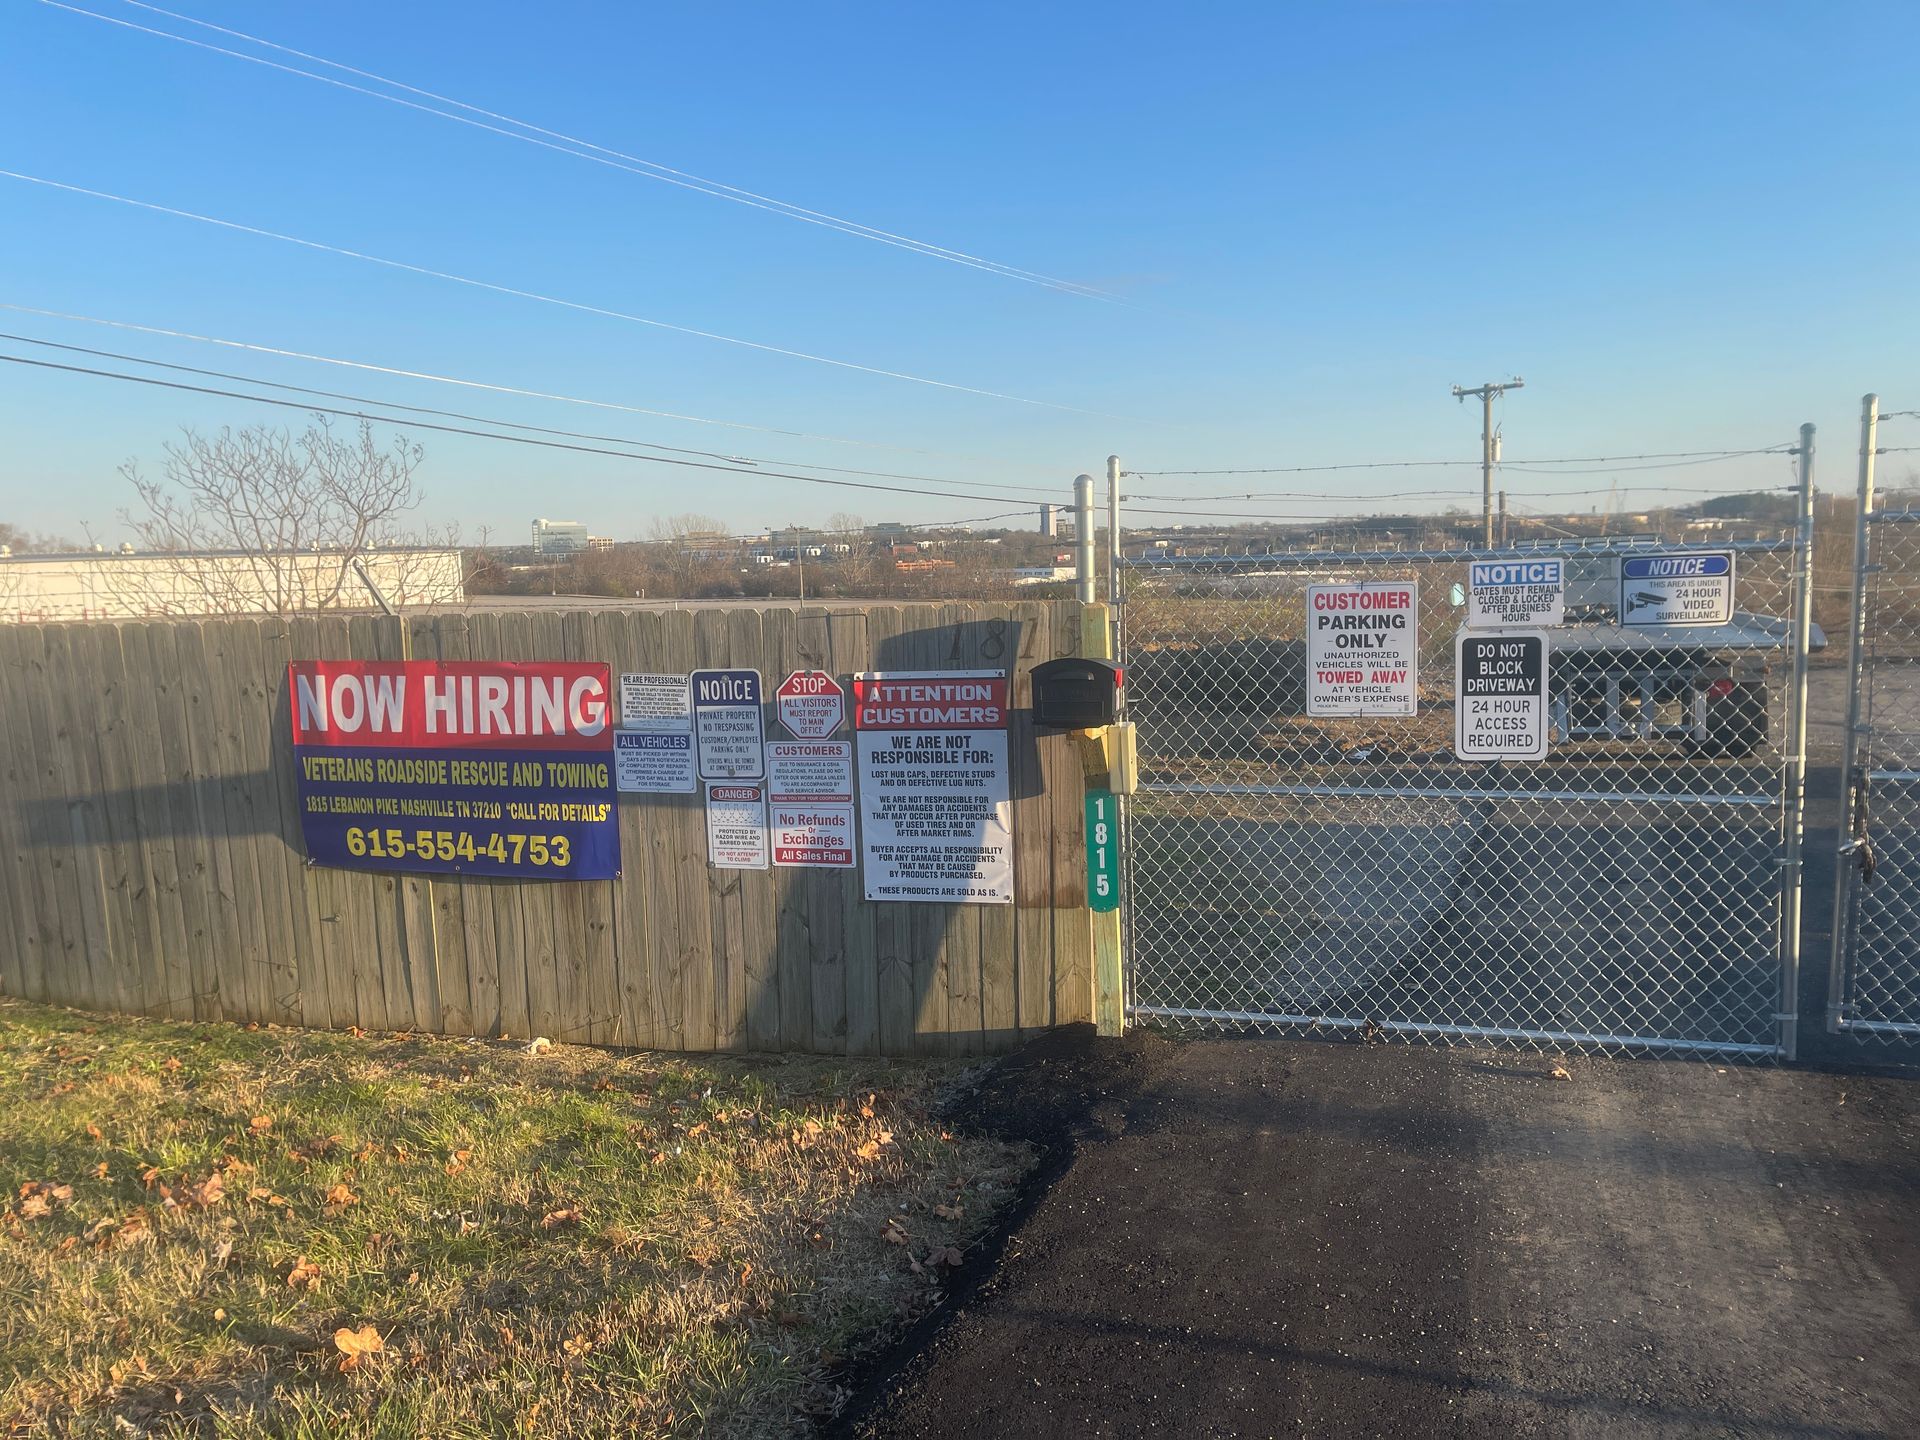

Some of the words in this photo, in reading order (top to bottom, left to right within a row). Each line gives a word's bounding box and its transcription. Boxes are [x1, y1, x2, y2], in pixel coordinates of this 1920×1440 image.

[1648, 559, 1706, 576] NOTICE
[1474, 566, 1558, 585] NOTICE
[1696, 579, 1722, 587] UNDER
[1473, 587, 1500, 596] GATES
[1502, 586, 1526, 595] MUST
[1527, 584, 1560, 595] REMAIN
[1676, 589, 1689, 598] 24
[1693, 588, 1721, 598] HOUR
[1314, 591, 1410, 610] CUSTOMER
[1478, 594, 1510, 604] CLOSED
[1512, 594, 1518, 604] &
[1521, 594, 1555, 603] LOCKED
[1683, 600, 1715, 609] VIDEO
[1481, 604, 1508, 614] AFTER
[1509, 603, 1551, 613] BUSINESS
[1501, 613, 1531, 622] HOURS
[1655, 611, 1721, 620] SURVEILLANCE
[1318, 614, 1406, 630] PARKING
[1335, 634, 1387, 648] ONLY
[1324, 651, 1399, 659] UNAUTHORIZED
[1477, 644, 1494, 658] DO
[1500, 643, 1526, 658] NOT
[1479, 661, 1523, 675] BLOCK
[632, 676, 642, 684] ARE
[643, 676, 688, 685] PROFESSIONALS
[1317, 671, 1363, 684] TOWED
[1370, 671, 1406, 683] AWAY
[699, 680, 753, 701] NOTICE
[792, 677, 827, 693] STOP
[1467, 678, 1535, 692] DRIVEWAY
[868, 683, 992, 703] ATTENTION
[297, 674, 409, 733] NOW
[424, 675, 606, 736] HIRING
[784, 699, 799, 707] ALL
[801, 698, 837, 707] VISITORS
[1471, 701, 1488, 714] 24
[1494, 700, 1530, 713] HOUR
[699, 711, 724, 720] PRIVATE
[726, 711, 756, 720] PROPERTY
[808, 709, 832, 717] REPORT
[863, 706, 1000, 724] CUSTOMERS
[703, 723, 712, 732] NO
[714, 722, 755, 732] TRESPASSING
[799, 718, 807, 726] TO
[808, 718, 824, 726] MAIN
[1475, 717, 1527, 730] ACCESS
[620, 736, 638, 748] ALL
[639, 736, 687, 748] VEHICLES
[700, 735, 759, 746] CUSTOMER/EMPLOYEE
[891, 736, 912, 748] WE
[915, 736, 941, 748] ARE
[947, 735, 971, 748] NOT
[1468, 734, 1533, 747] REQUIRED
[775, 746, 843, 756] CUSTOMERS
[871, 751, 959, 763] RESPONSIBLE
[964, 751, 994, 763] FOR:
[302, 756, 374, 783] VETERANS
[377, 758, 447, 785] ROADSIDE
[451, 760, 508, 786] RESCUE
[512, 761, 543, 787] AND
[548, 762, 609, 789] TOWING
[896, 779, 907, 787] OR
[909, 779, 947, 787] DEFECTIVE
[949, 779, 963, 787] LUG
[965, 779, 986, 787] NUTS.
[718, 789, 753, 799] DANGER
[306, 796, 328, 813] 1815
[330, 796, 374, 815] LEBANON
[376, 798, 399, 815] PIKE
[401, 798, 454, 817] NASHVILLE
[455, 800, 470, 818] TN
[473, 800, 501, 818] 37210
[505, 801, 537, 820] “CALL
[539, 802, 560, 820] FOR
[562, 802, 611, 822] DETAILS”
[882, 804, 896, 812] ANY
[898, 804, 932, 812] DAMAGES
[779, 813, 794, 825] No
[799, 814, 845, 826] Refunds
[872, 812, 889, 820] THAT
[892, 812, 907, 820] MAY
[960, 813, 999, 821] PURCHASE
[895, 821, 903, 829] OF
[905, 821, 923, 829] USED
[925, 821, 945, 829] TIRES
[947, 821, 962, 829] AND
[965, 821, 976, 829] OR
[782, 833, 844, 848] Exchanges
[346, 827, 571, 867] 615-554-4753
[895, 846, 928, 854] ACCEPTS
[930, 846, 942, 854] ALL
[944, 846, 1003, 854] RESPONSIBILITY
[1095, 797, 1110, 897] 1815
[782, 850, 793, 860] All
[795, 851, 820, 861] Sales
[823, 851, 846, 861] Final
[878, 854, 892, 862] FOR
[894, 854, 907, 862] ANY
[910, 854, 940, 862] DAMAGE
[948, 863, 976, 871] CAUSED
[901, 871, 940, 879] PRODUCTS
[940, 871, 986, 880] PURCHASED.
[878, 886, 900, 894] THESE
[902, 887, 939, 895] PRODUCTS
[941, 888, 955, 896] ARE
[957, 888, 975, 896] SOLD
[977, 888, 987, 896] AS
